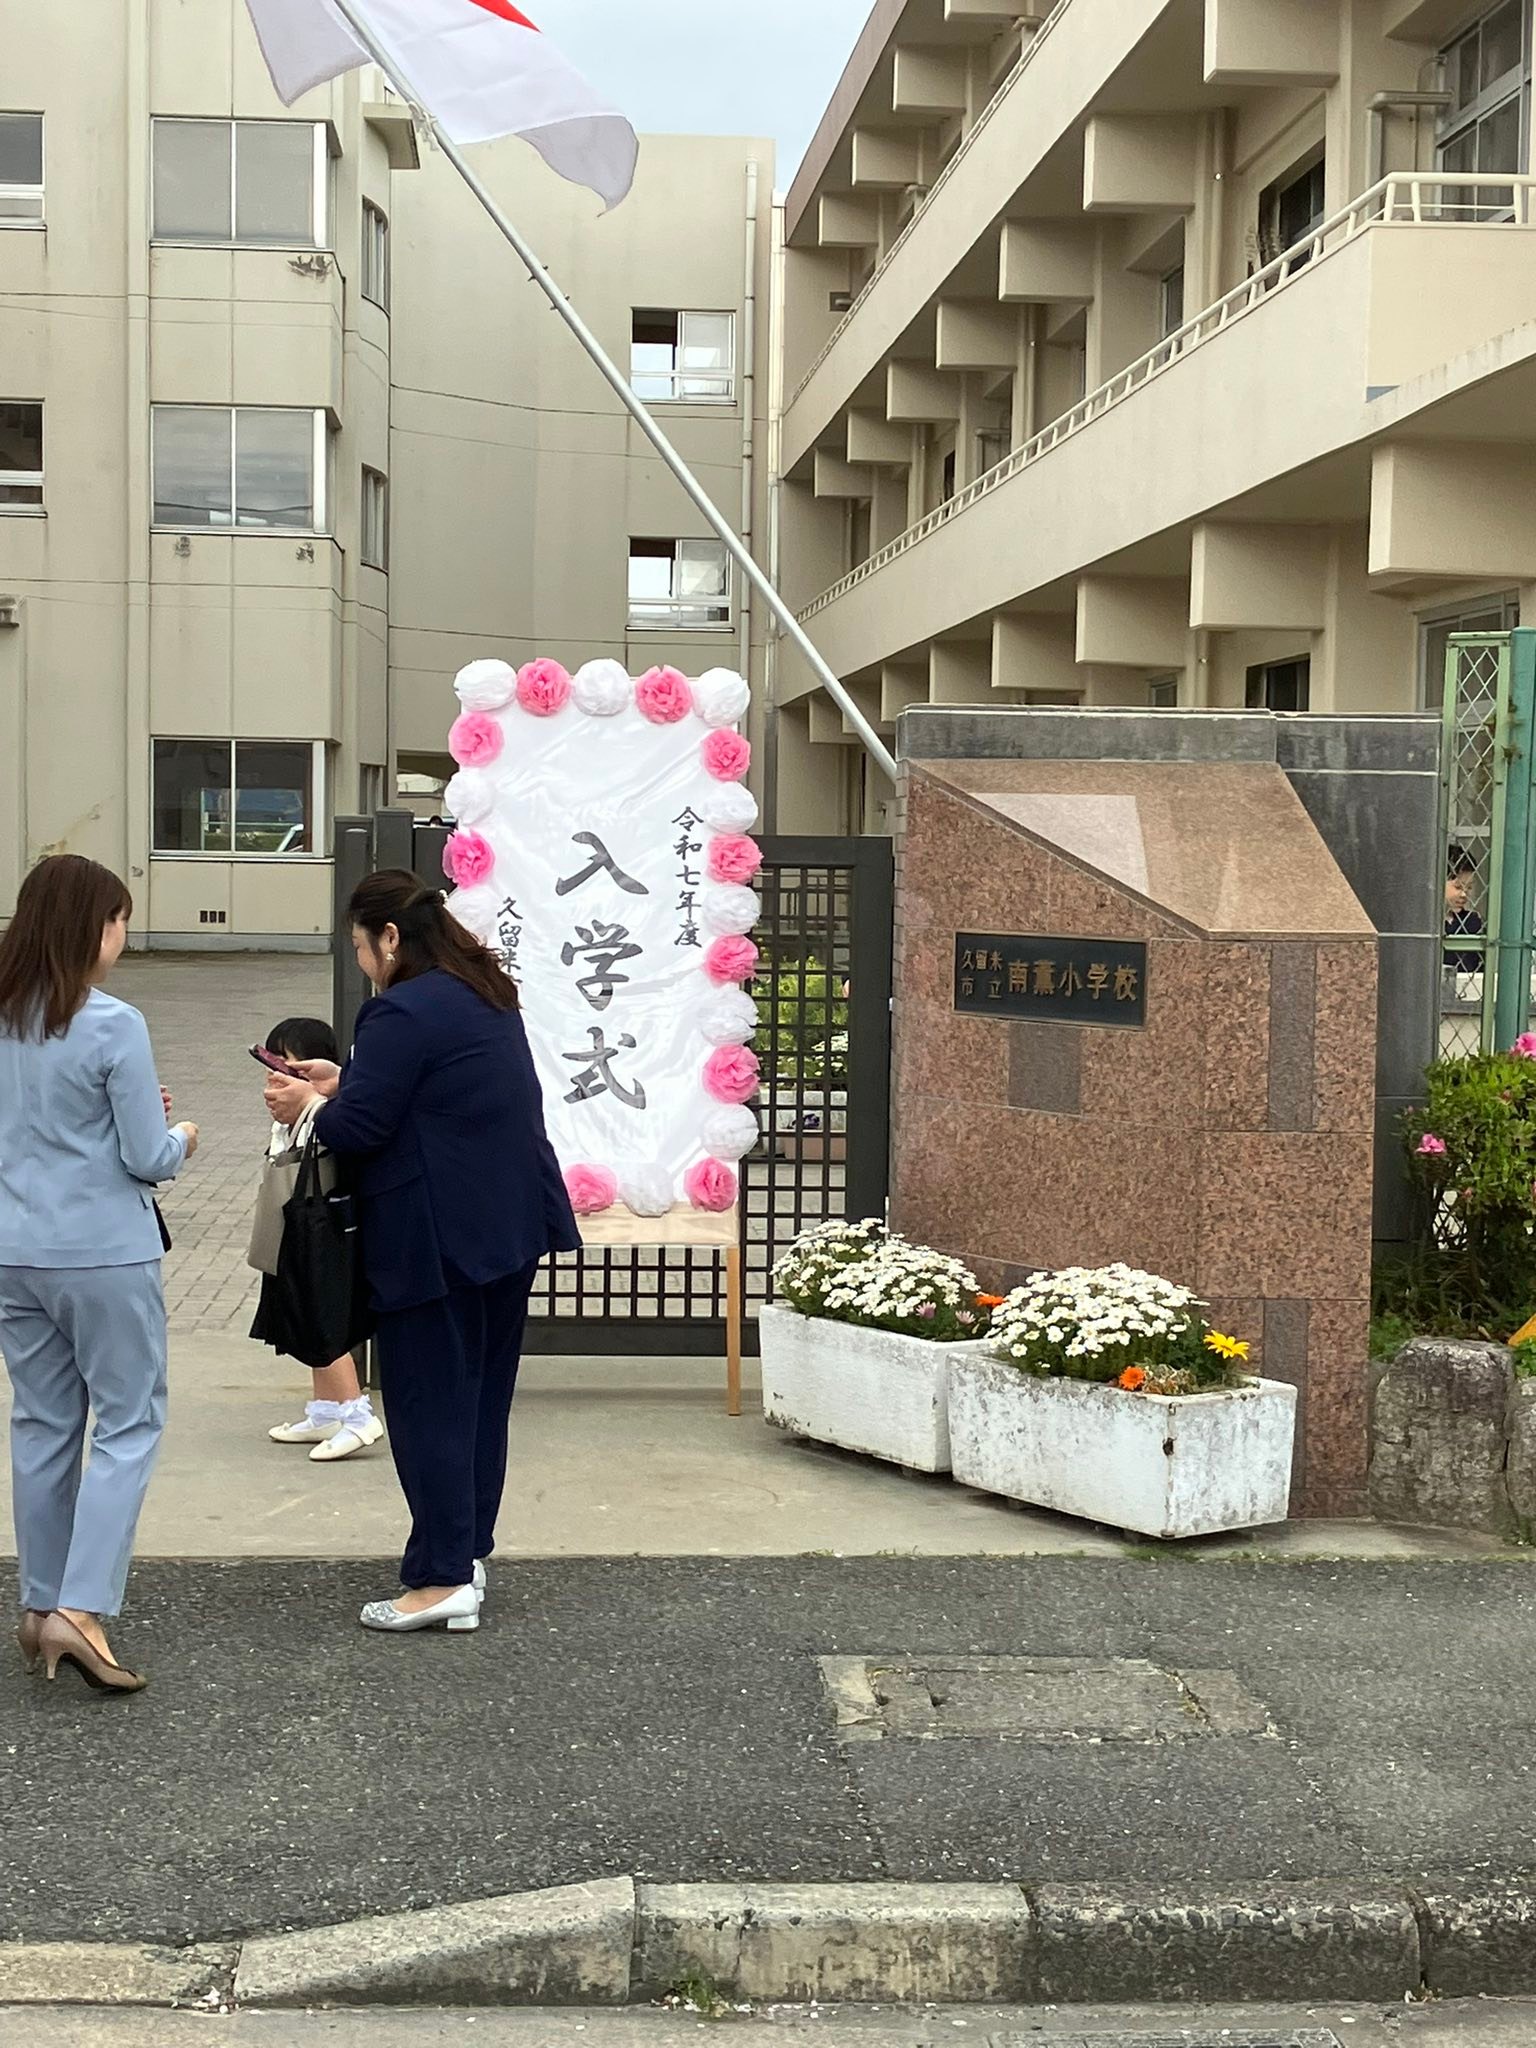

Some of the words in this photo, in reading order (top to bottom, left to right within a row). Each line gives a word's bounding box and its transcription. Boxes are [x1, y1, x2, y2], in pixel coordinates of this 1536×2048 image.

[671, 806, 704, 948] 令和七年度
[497, 896, 523, 984] 久留米
[555, 831, 650, 1111] 入学式
[961, 950, 1003, 972] 久留米
[960, 976, 1002, 999] 市立
